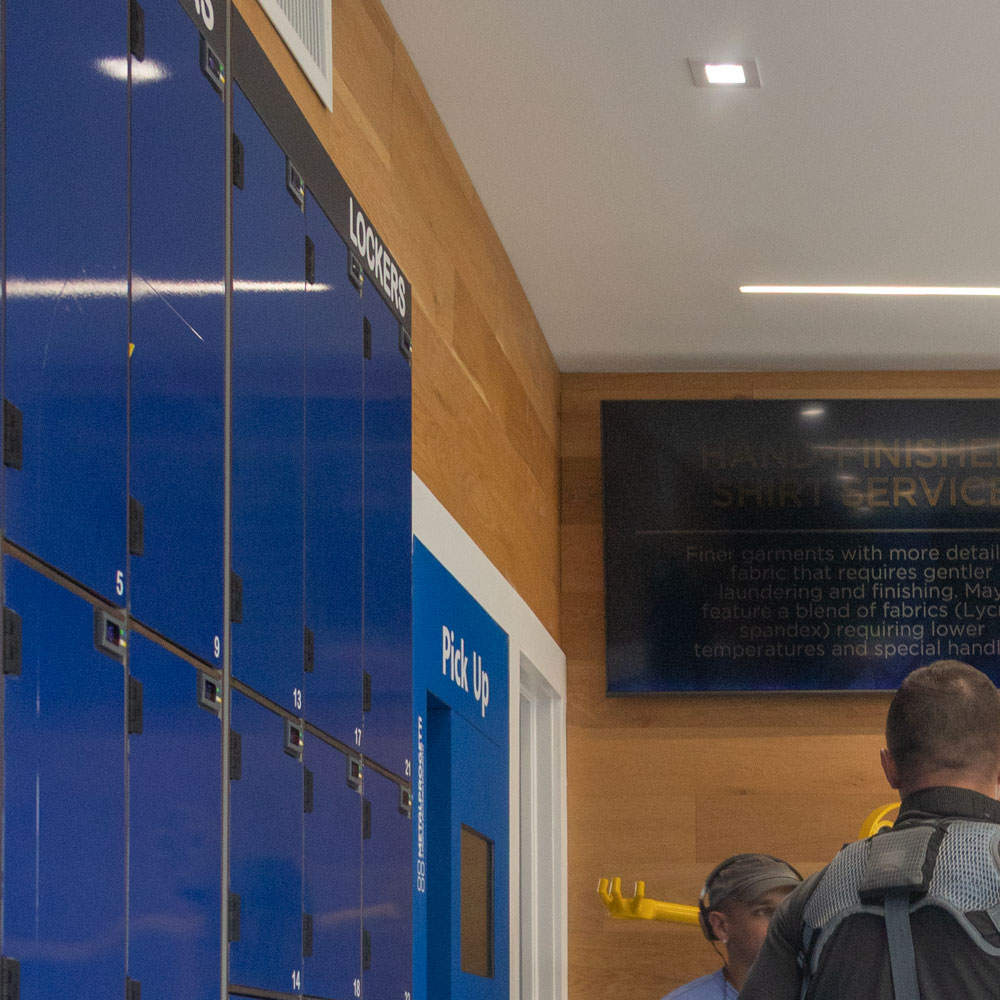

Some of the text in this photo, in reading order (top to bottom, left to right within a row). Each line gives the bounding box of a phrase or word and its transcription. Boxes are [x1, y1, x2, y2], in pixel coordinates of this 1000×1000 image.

[349, 196, 406, 318] LOCKERS
[713, 477, 826, 508] SHIRT
[687, 546, 734, 562] Finer
[742, 545, 834, 566] garments
[842, 545, 882, 561] with
[889, 547, 940, 561] more
[115, 570, 124, 596] 5
[731, 564, 992, 583] fabric that requires gentler
[720, 583, 823, 603] laundering
[830, 584, 865, 600] and
[872, 583, 959, 601] finishing.
[702, 603, 773, 619] feature
[778, 607, 789, 618] a
[796, 603, 850, 619] blend
[857, 602, 877, 618] of
[883, 602, 948, 618] fabrics
[740, 621, 985, 640] spandex) requiring lower
[213, 636, 220, 658] 9
[694, 642, 825, 660] temperatures
[831, 641, 867, 657] and
[875, 640, 941, 659] special
[442, 625, 490, 718] Pick Up
[293, 688, 302, 710] 13
[354, 728, 362, 747] 17
[291, 971, 300, 990] 14
[353, 978, 361, 998] 18
